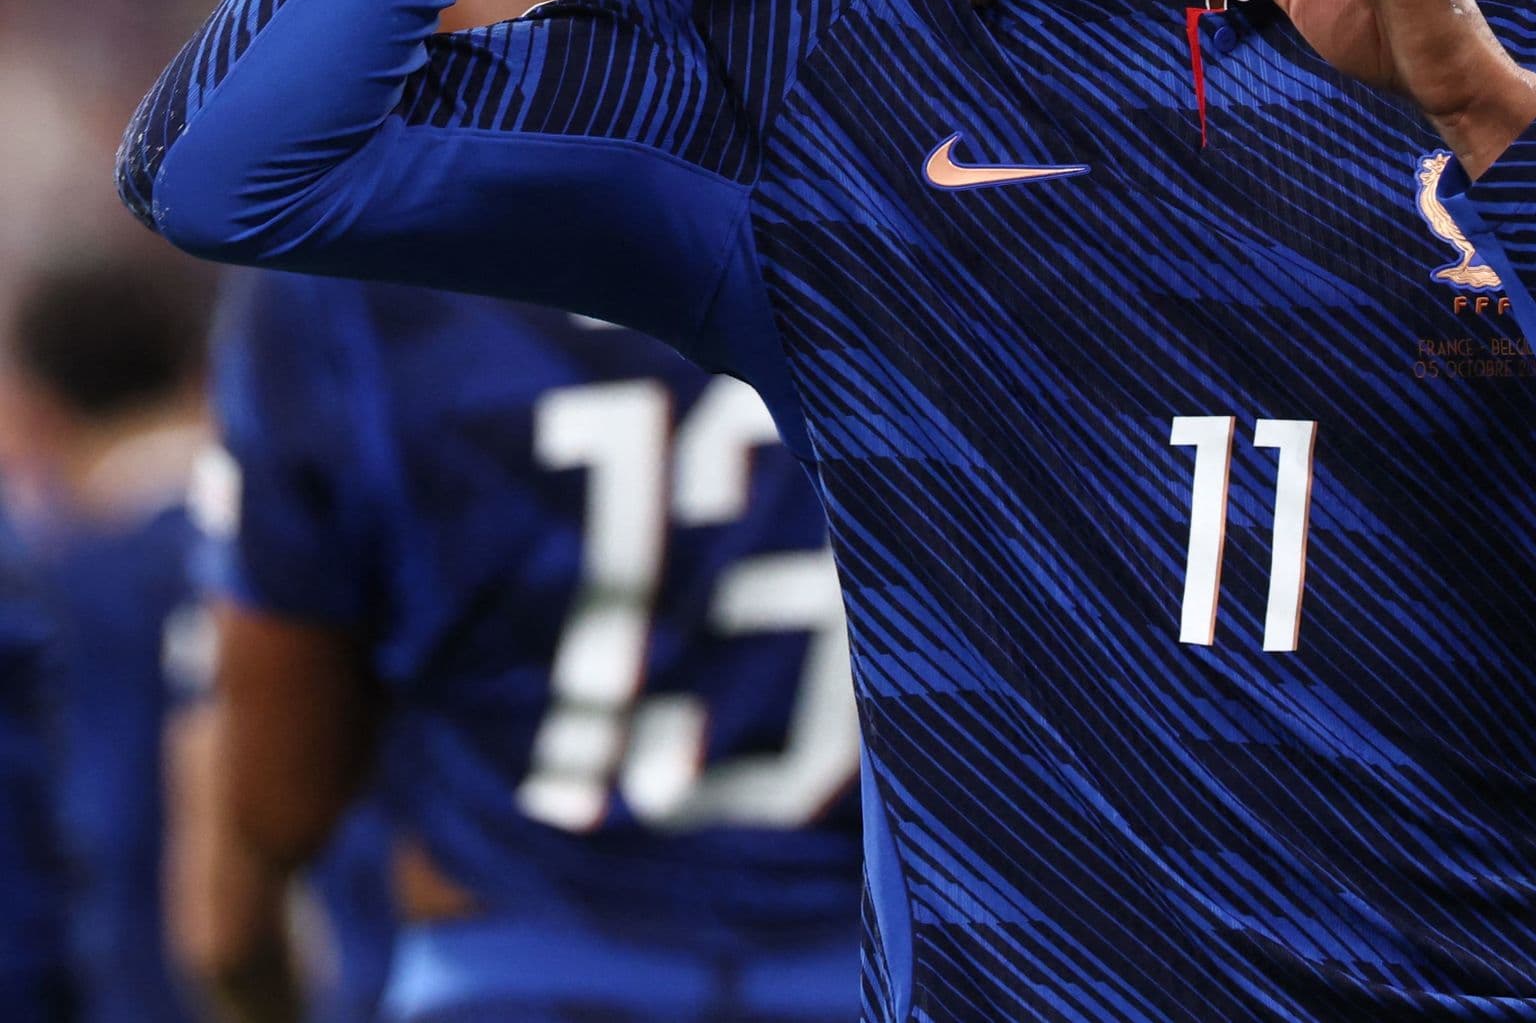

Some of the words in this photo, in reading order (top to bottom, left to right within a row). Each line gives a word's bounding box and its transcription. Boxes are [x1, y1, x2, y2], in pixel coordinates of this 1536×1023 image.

[1413, 360, 1439, 378] 05
[1447, 359, 1513, 377] OCTOBRE
[1418, 339, 1473, 356] FRANCE
[1170, 416, 1318, 652] 11
[515, 373, 861, 832] 13
